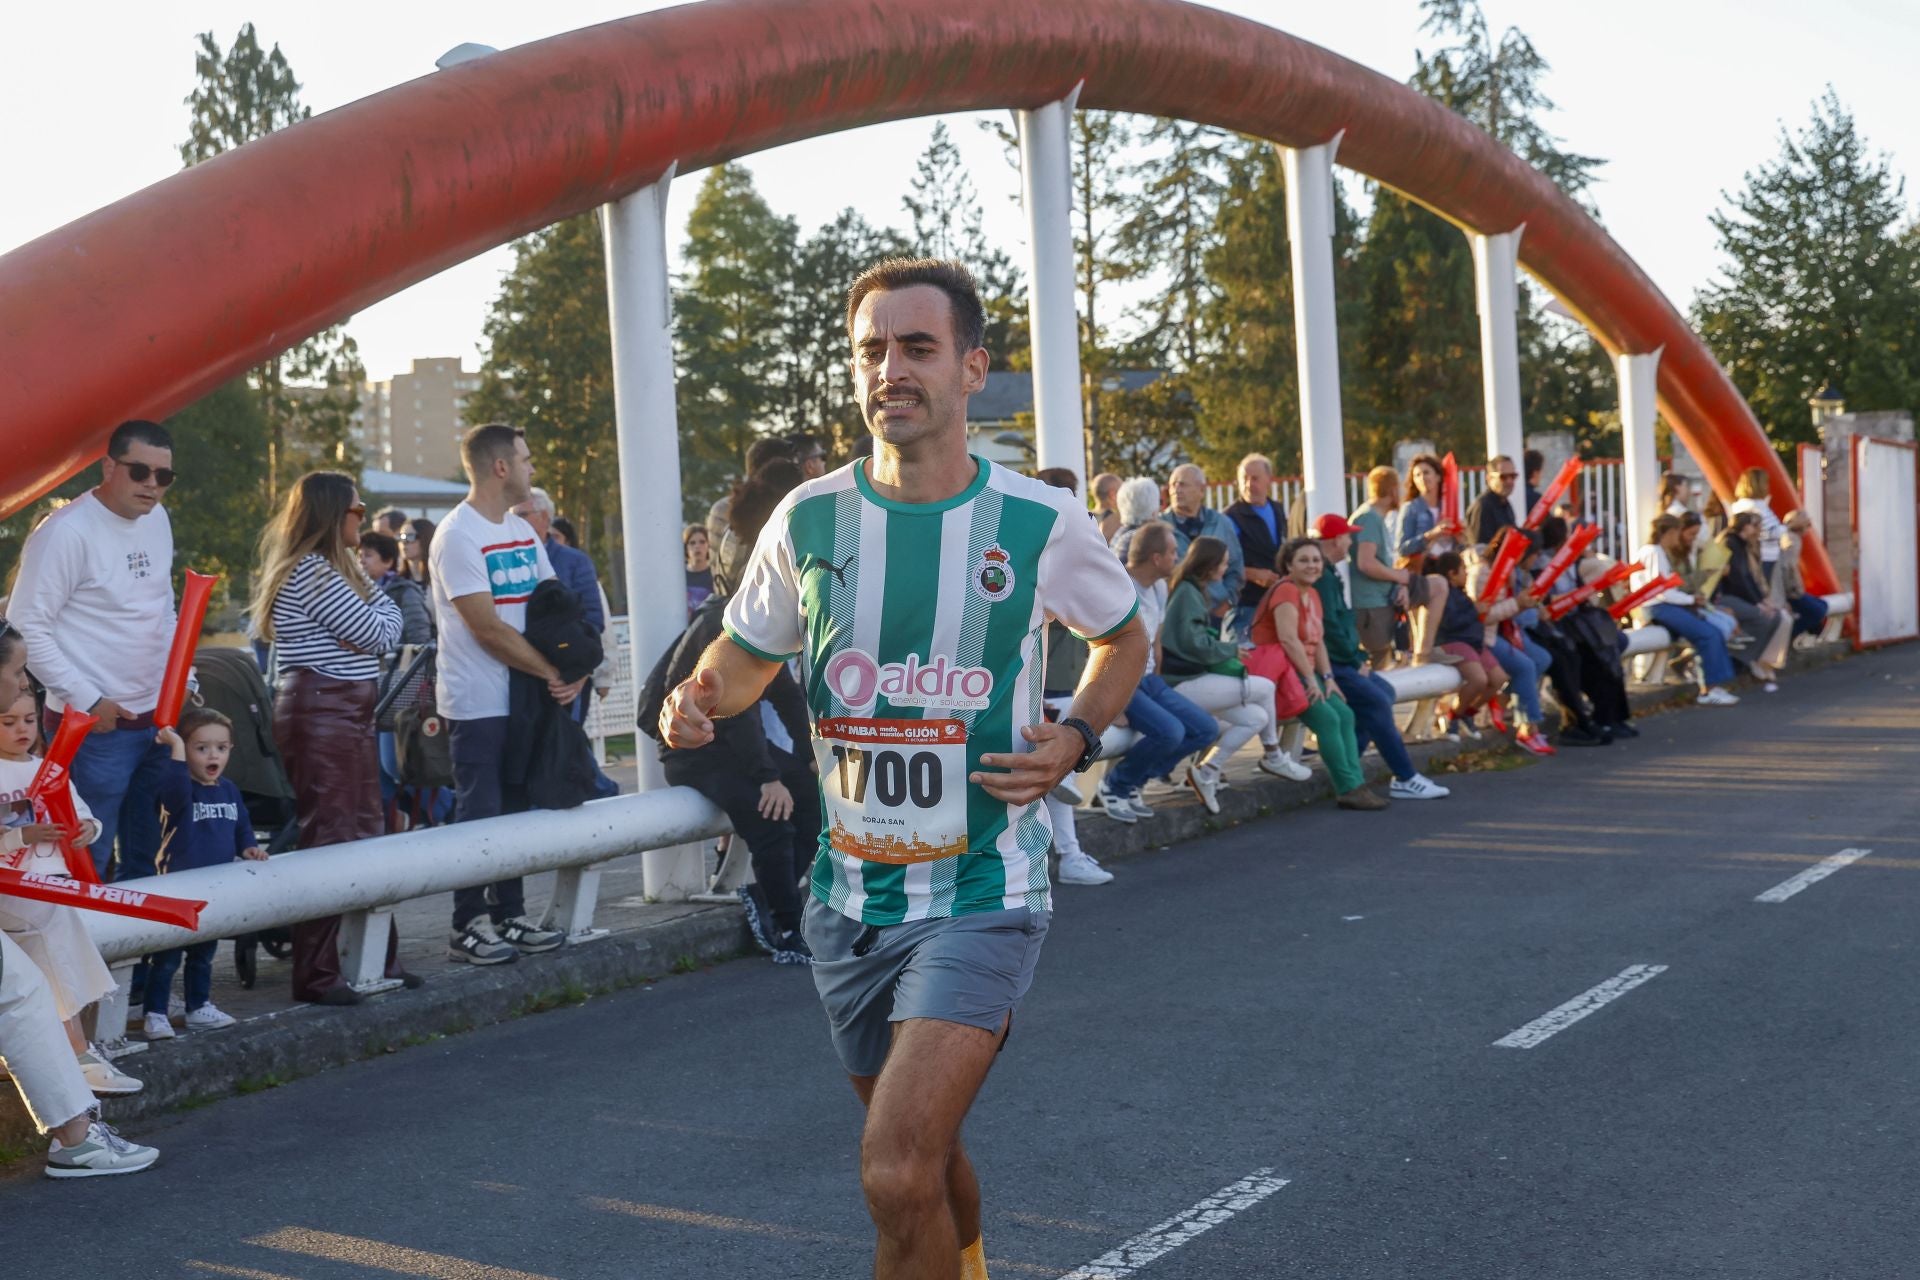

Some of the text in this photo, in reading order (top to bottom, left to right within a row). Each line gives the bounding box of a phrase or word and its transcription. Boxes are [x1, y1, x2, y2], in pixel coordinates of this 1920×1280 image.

[880, 656, 991, 698] aldro
[848, 726, 878, 737] MBA
[904, 726, 939, 738] GIJÓN
[831, 744, 943, 809] 1700
[862, 815, 905, 826] BORJA SAN
[89, 884, 148, 907] MBA
